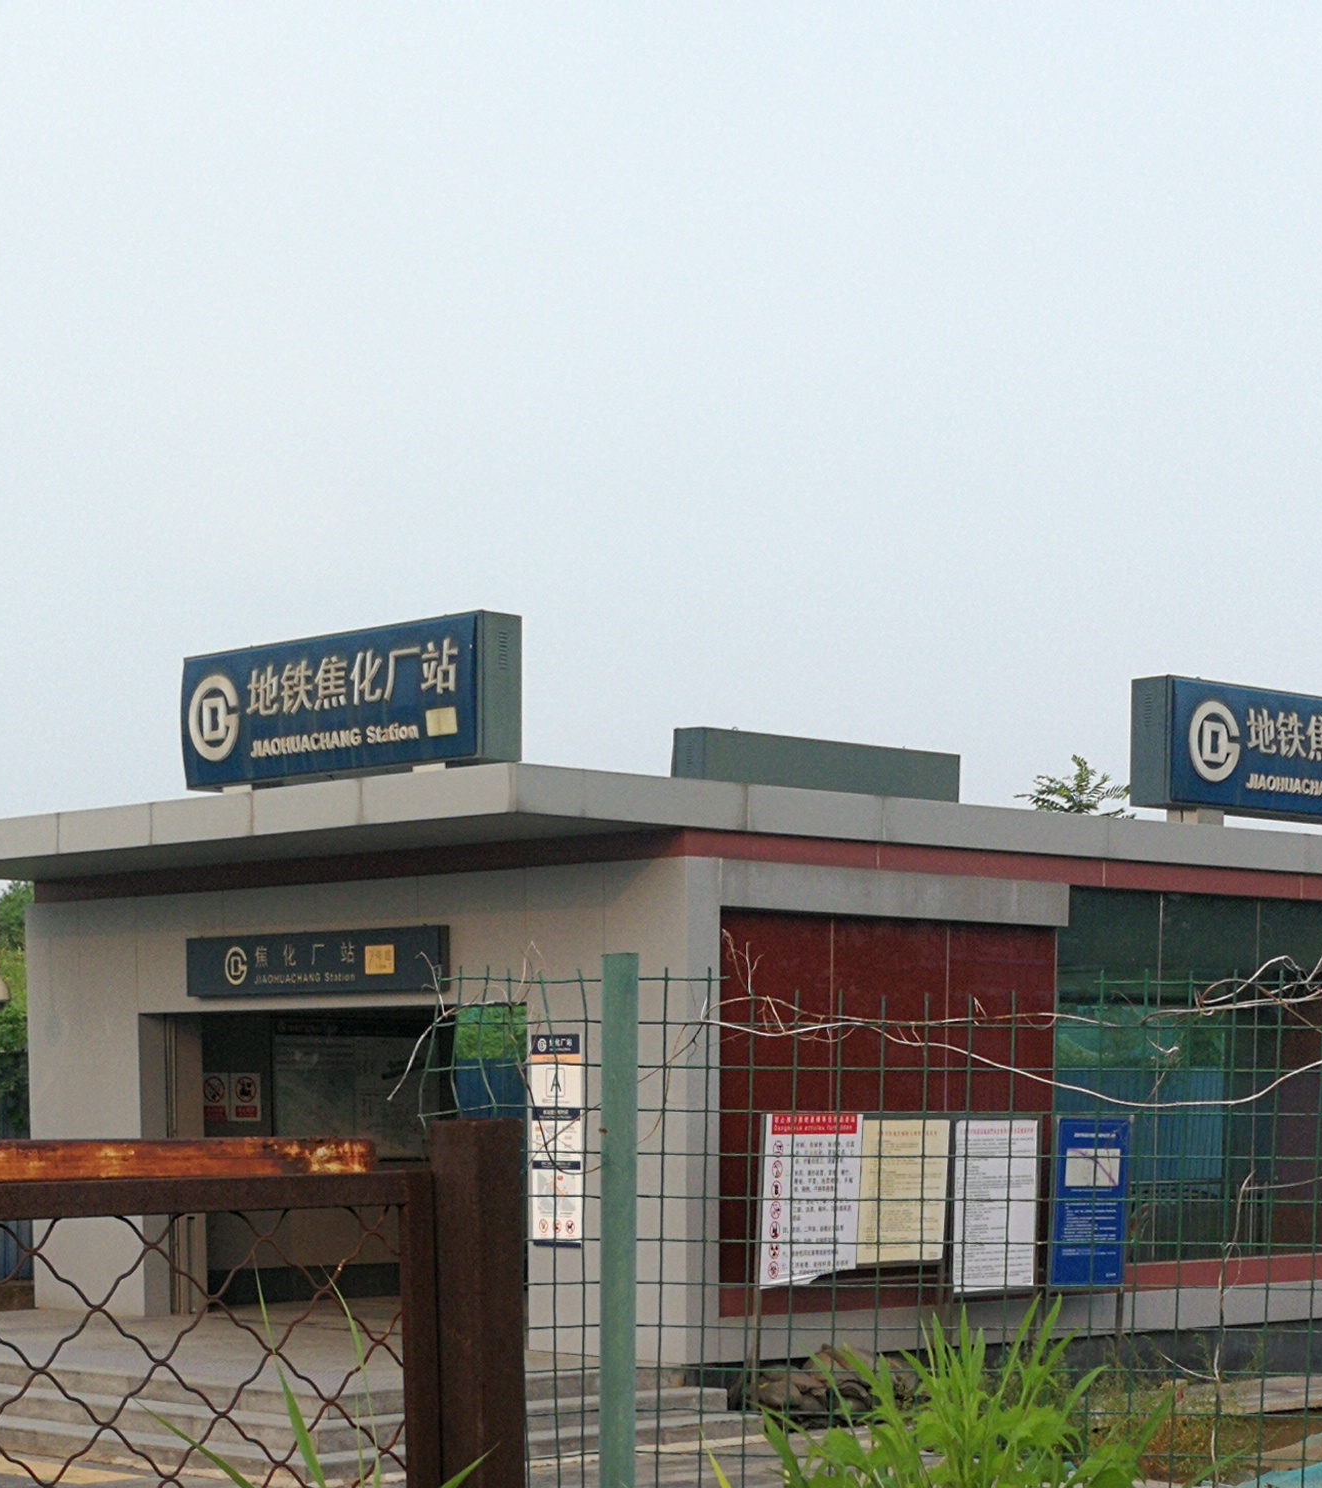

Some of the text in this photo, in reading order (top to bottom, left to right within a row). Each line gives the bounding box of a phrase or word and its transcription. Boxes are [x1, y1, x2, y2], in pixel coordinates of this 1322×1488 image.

[246, 637, 459, 717] 地铁焦化厂站
[250, 723, 420, 759] JIAOHUACHANG Station
[255, 942, 355, 967] 焦化厂站
[253, 971, 356, 985] JIAOHUACHANG Station
